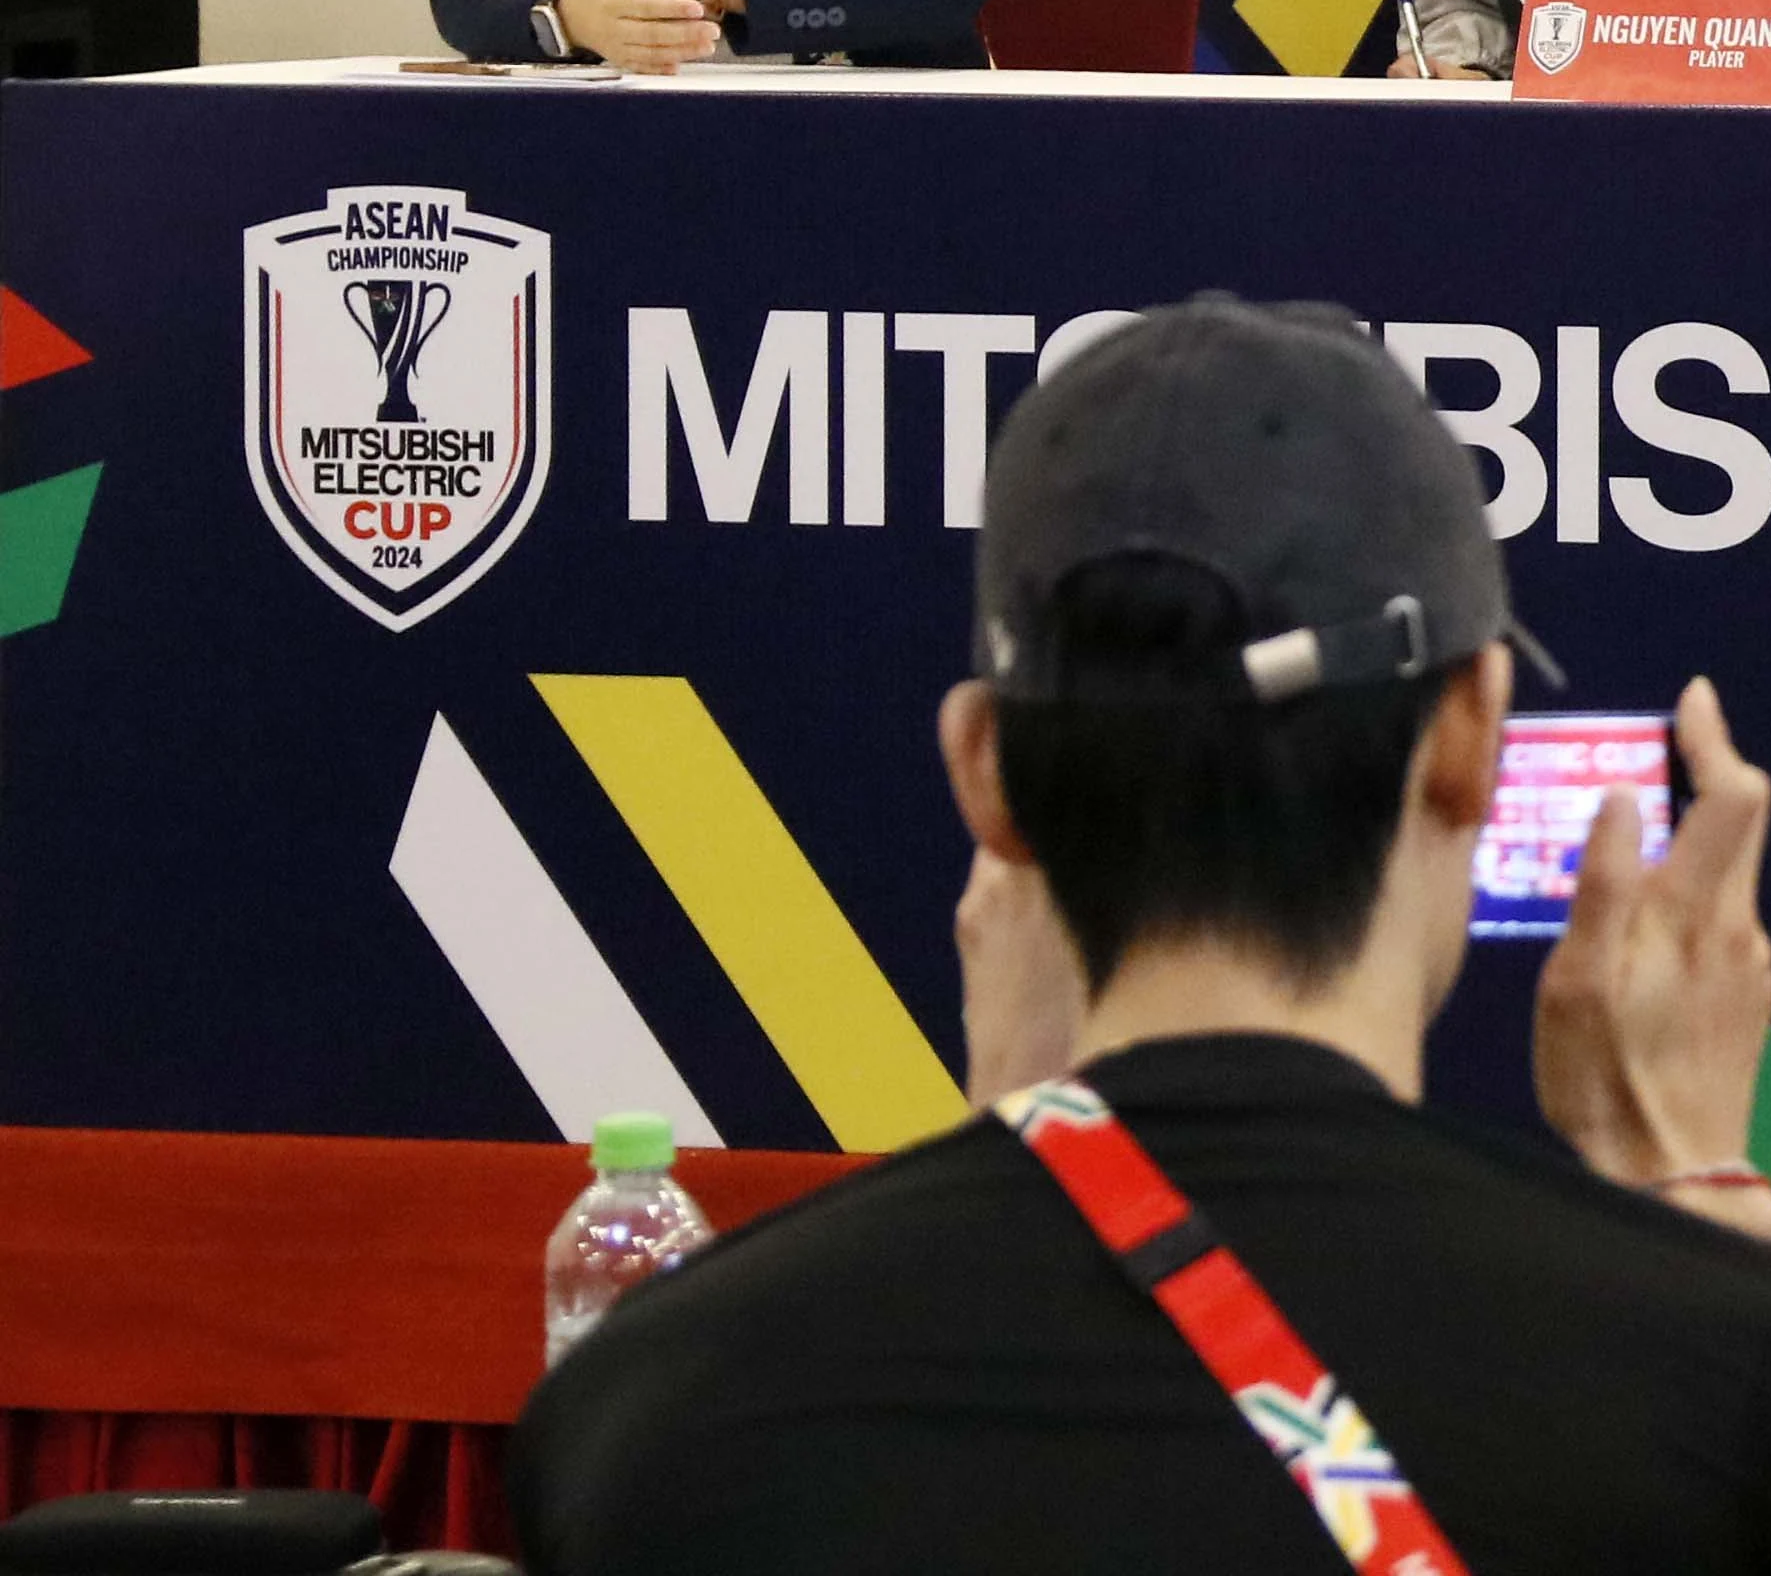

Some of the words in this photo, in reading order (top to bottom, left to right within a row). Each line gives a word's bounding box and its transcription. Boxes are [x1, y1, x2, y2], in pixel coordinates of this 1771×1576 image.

[1593, 15, 1696, 44] NGUYEN
[1689, 50, 1744, 69] PLAYER
[346, 202, 448, 240] ASEAN
[328, 247, 468, 273] CHAMPIONSHIP
[302, 428, 493, 460] MITSUBISHI
[314, 463, 480, 497] ELECTRIC
[344, 501, 451, 540] CUP
[373, 546, 422, 569] 2024
